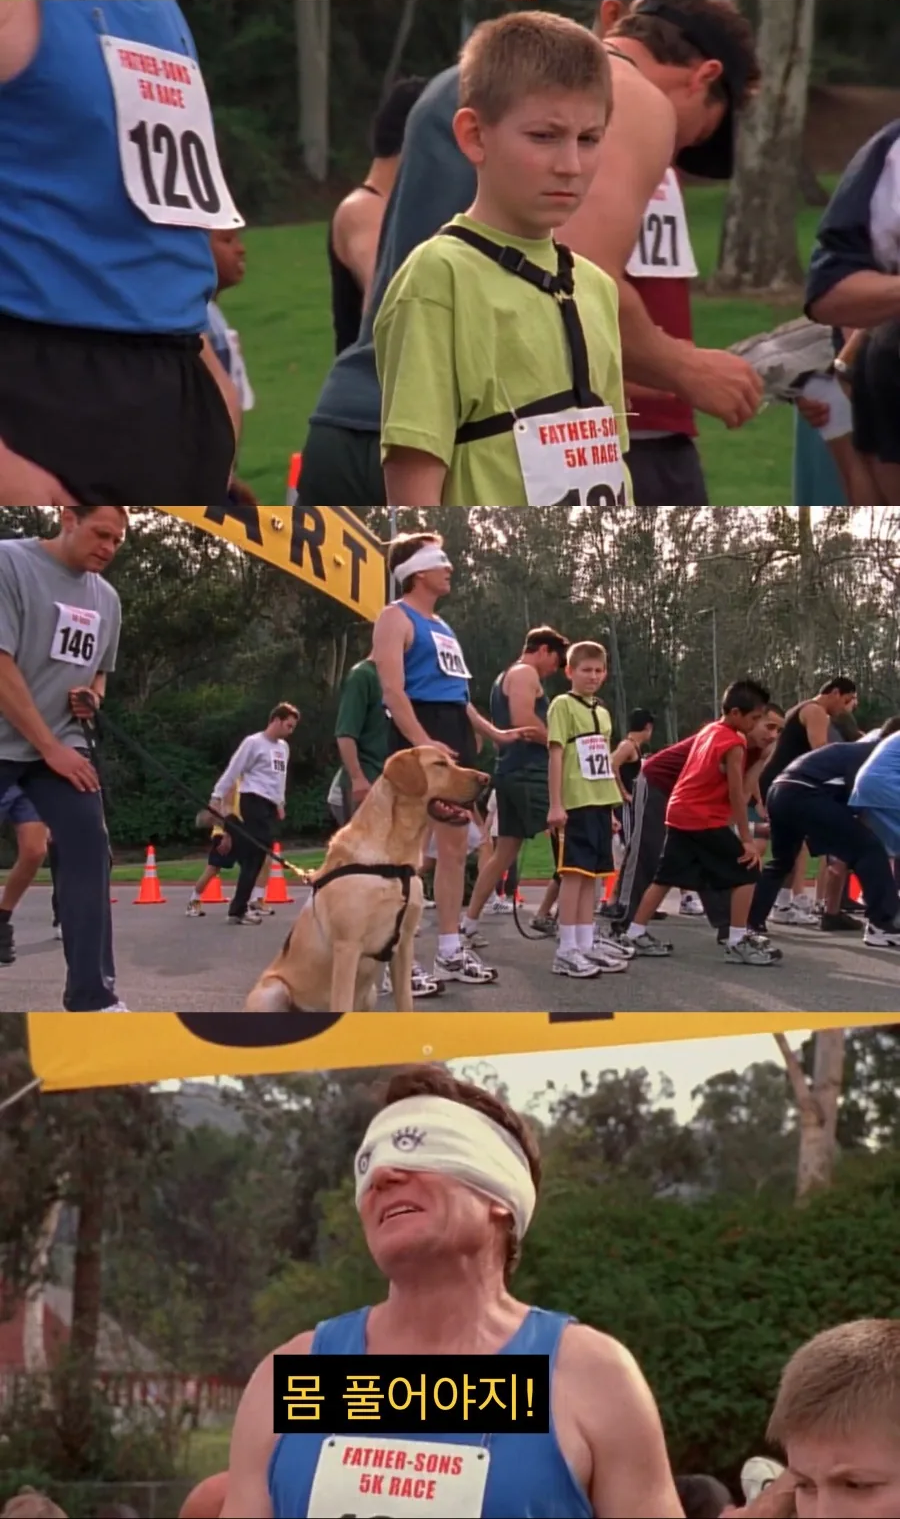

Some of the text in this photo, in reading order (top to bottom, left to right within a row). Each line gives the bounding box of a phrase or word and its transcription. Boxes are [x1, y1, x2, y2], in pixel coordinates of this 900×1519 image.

[117, 48, 192, 85] FATHER-SONS
[156, 83, 187, 109] RACE
[129, 119, 220, 214] 120
[564, 444, 619, 469] 5K RACE
[59, 627, 95, 661] 146
[440, 651, 468, 675] 120
[585, 753, 609, 776] 121
[342, 1446, 463, 1476] FATHER-SONS
[359, 1473, 437, 1500] 5K RACE
